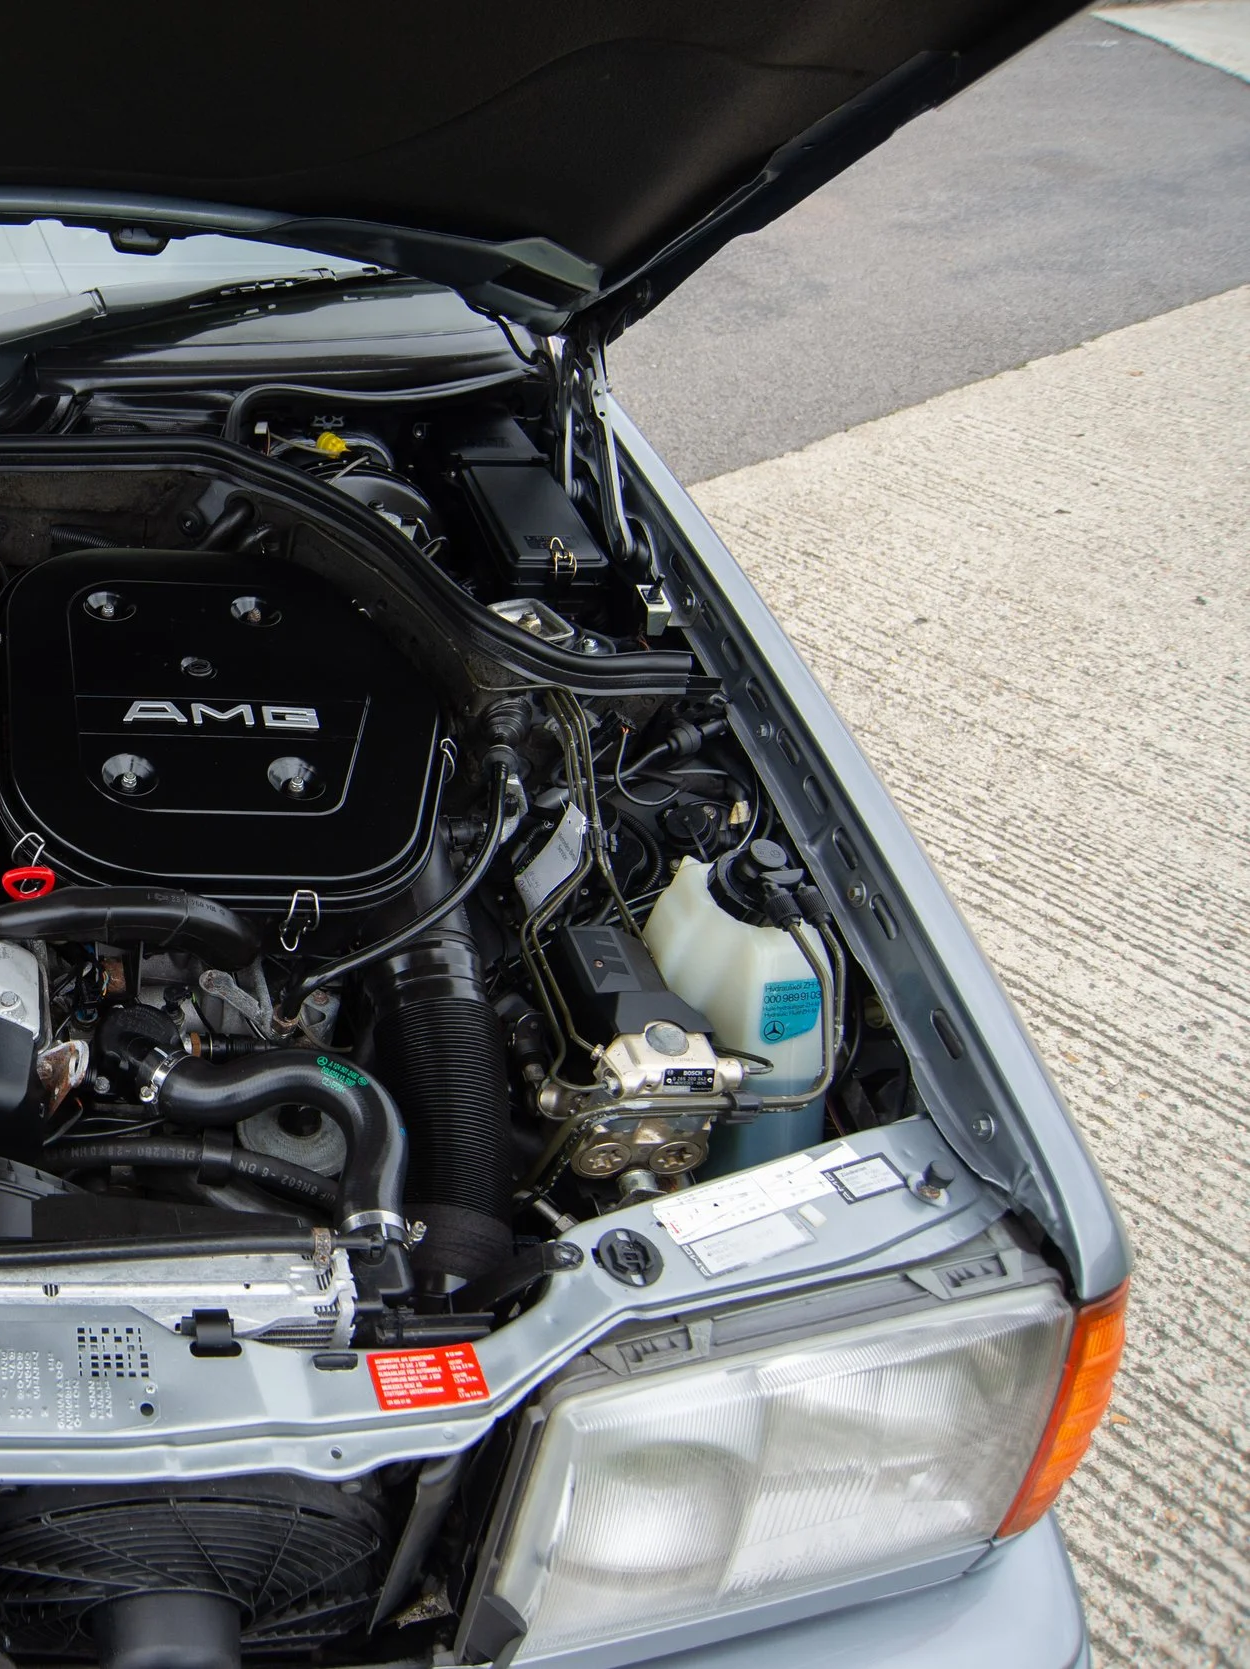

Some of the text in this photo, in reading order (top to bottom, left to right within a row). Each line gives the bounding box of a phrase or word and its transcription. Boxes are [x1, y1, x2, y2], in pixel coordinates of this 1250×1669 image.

[122, 700, 320, 730] AMG
[764, 990, 822, 1004] 000 989 91 03
[765, 984, 802, 993] Hydrauliköl
[824, 1171, 856, 1202] AMG
[682, 1245, 711, 1277] AMG
